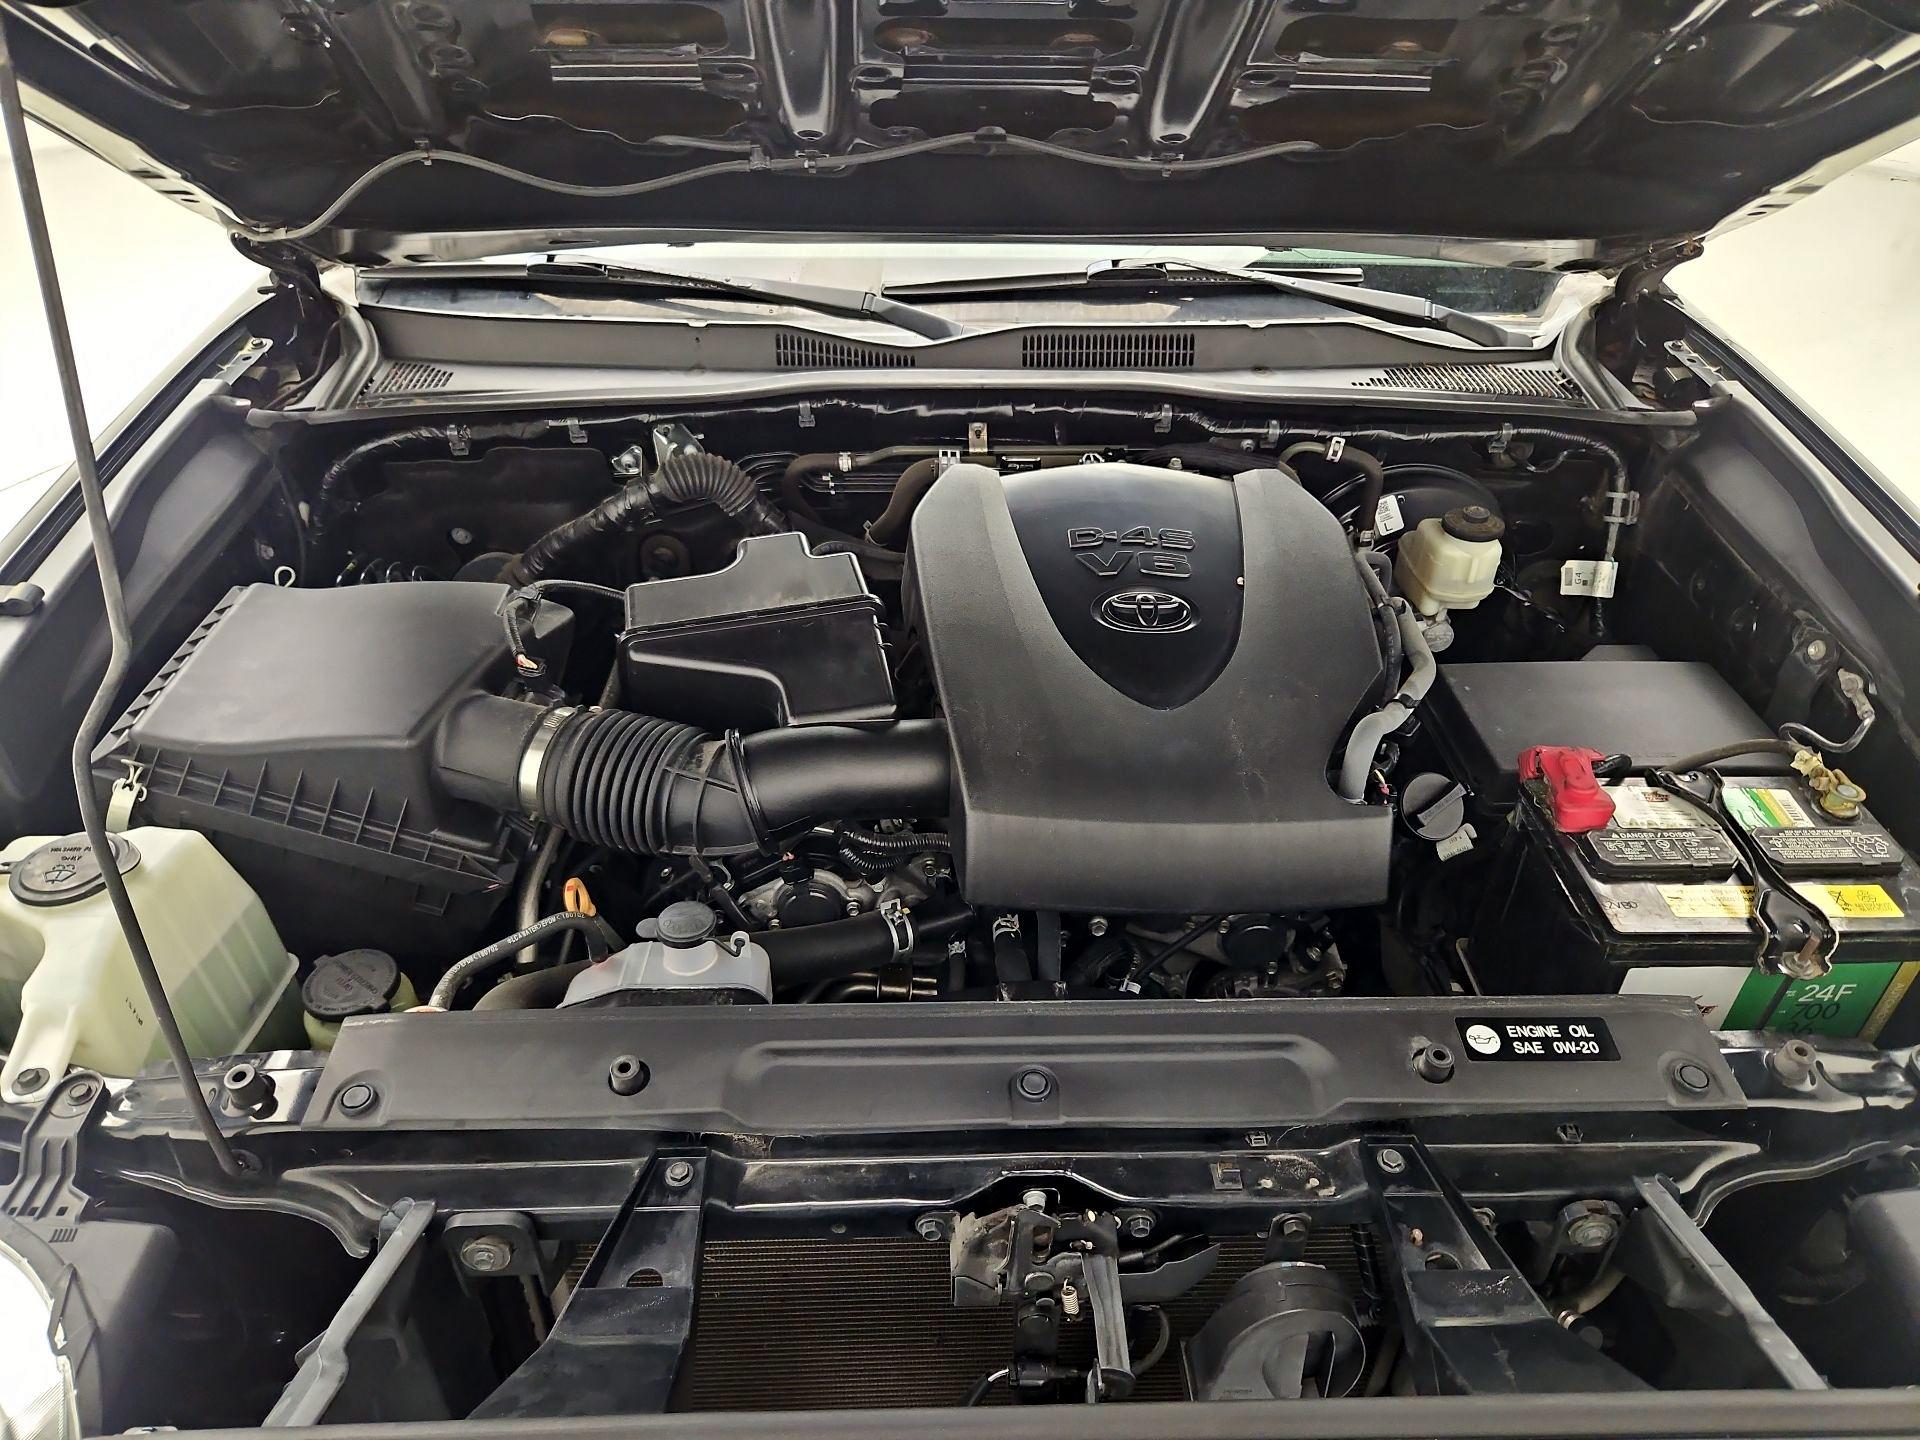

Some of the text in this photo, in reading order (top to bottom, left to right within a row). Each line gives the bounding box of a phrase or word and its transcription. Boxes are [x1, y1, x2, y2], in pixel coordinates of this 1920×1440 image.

[1067, 525, 1196, 550] D-4S
[1074, 550, 1192, 578] V6
[1797, 983, 1858, 1002] 24F
[1791, 1003, 1841, 1020] 700
[1506, 1024, 1595, 1038] ENGINE OIL
[1512, 1041, 1600, 1054] SAE 0W-20
